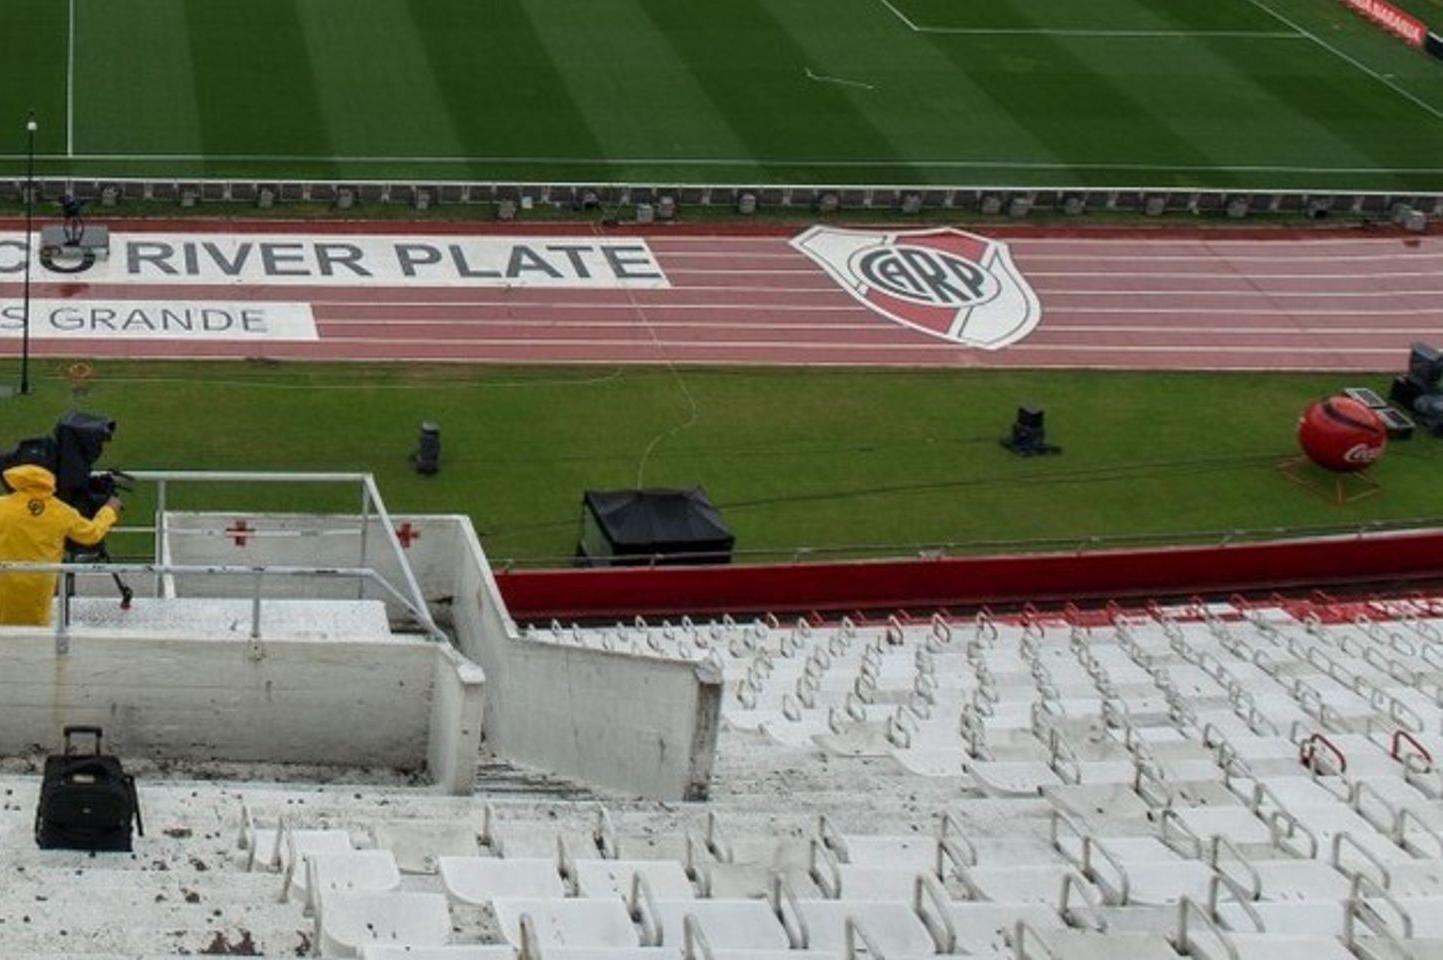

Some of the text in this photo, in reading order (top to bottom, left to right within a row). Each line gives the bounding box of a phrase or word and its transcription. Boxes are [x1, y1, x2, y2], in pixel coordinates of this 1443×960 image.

[127, 240, 372, 277] RIVER
[395, 243, 664, 280] PLATE
[858, 248, 987, 303] CARP
[50, 307, 269, 333] GRANDE
